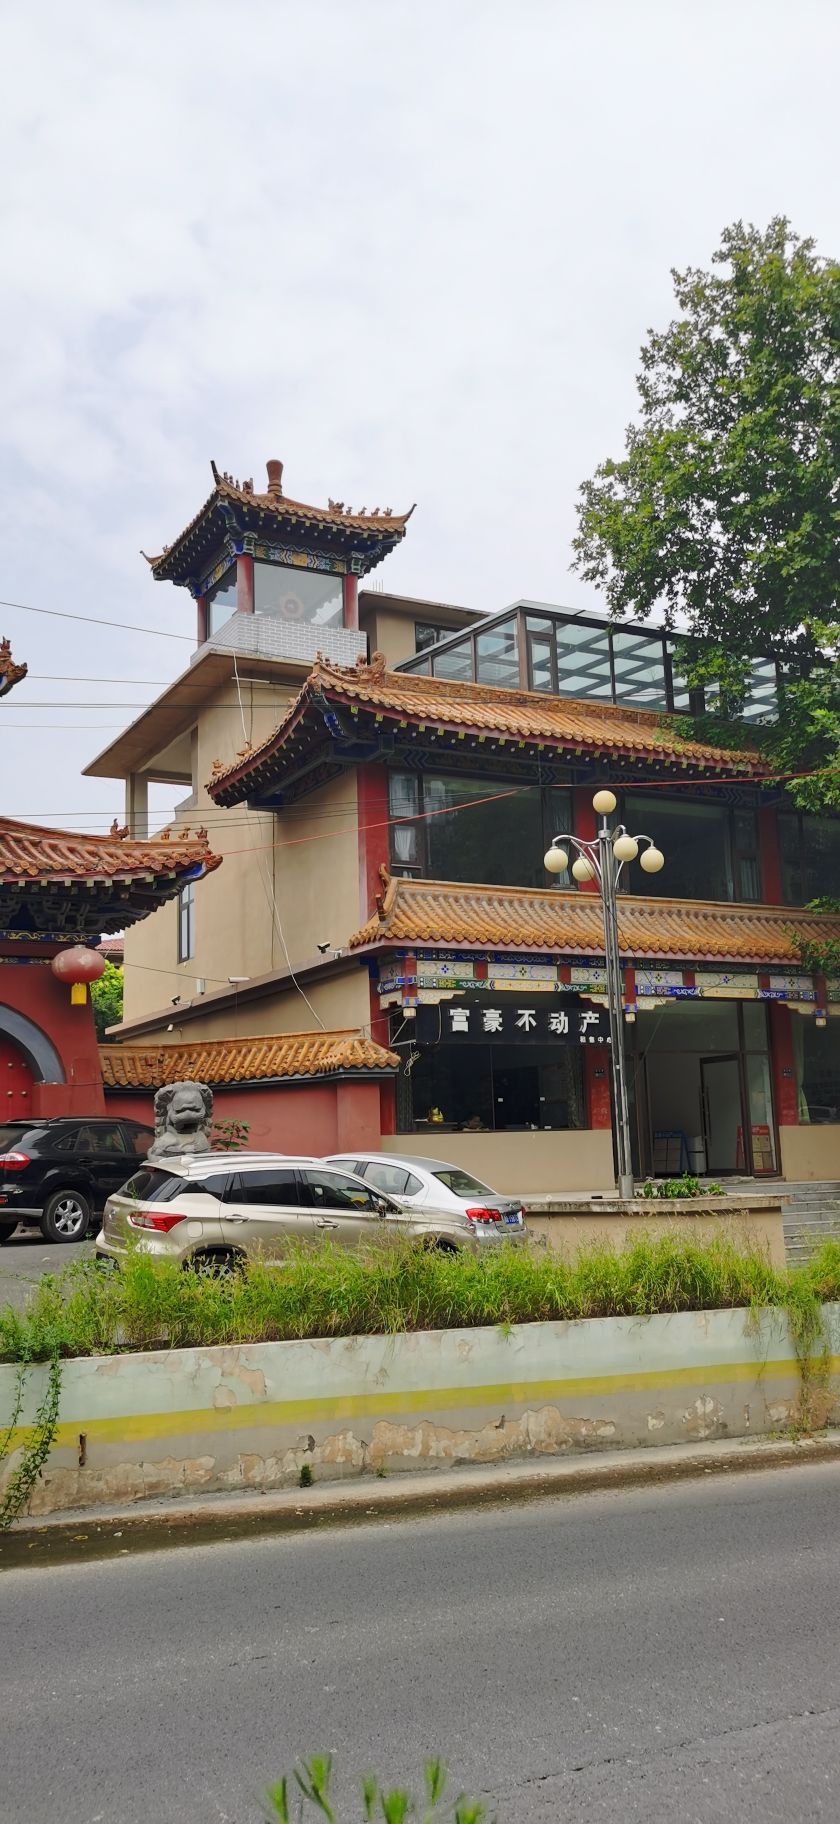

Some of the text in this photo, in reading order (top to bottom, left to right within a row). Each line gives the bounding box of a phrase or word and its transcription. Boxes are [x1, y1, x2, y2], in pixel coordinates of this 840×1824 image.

[449, 1008, 600, 1034] 富豪不动产
